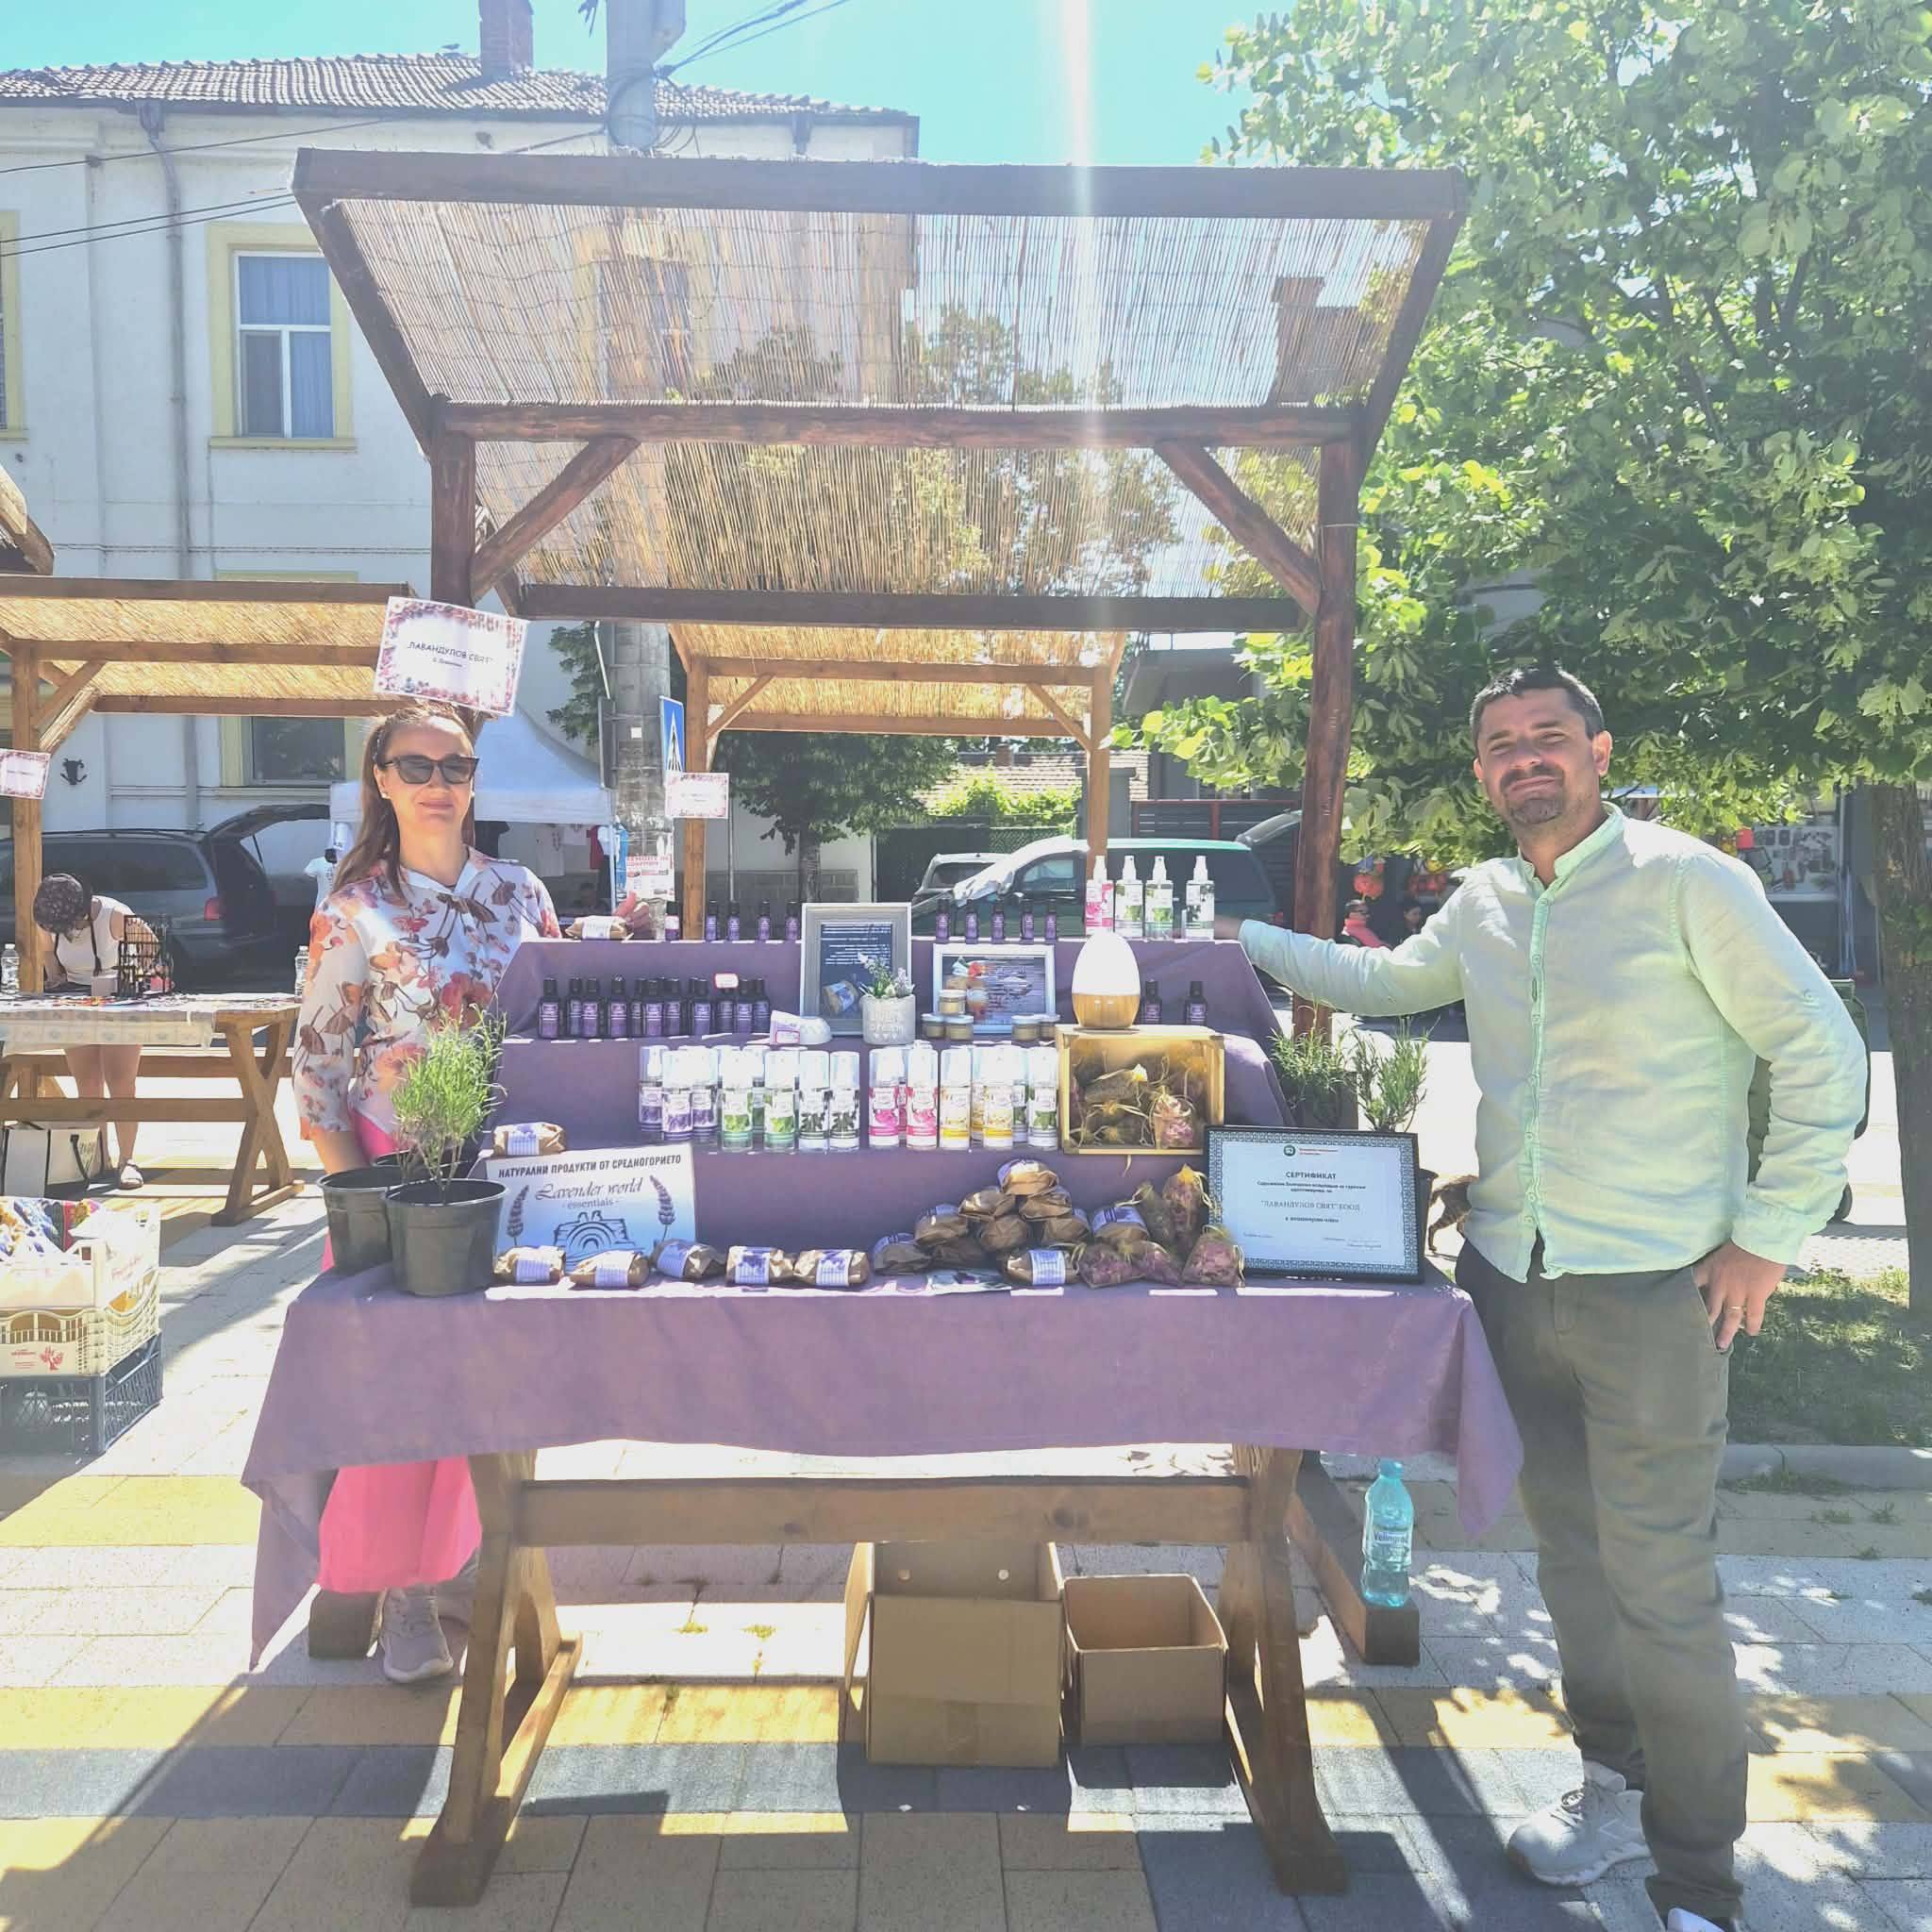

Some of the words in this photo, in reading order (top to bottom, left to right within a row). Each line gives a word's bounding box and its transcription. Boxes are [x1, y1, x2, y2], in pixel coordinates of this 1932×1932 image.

[498, 1164, 549, 1178] НАТУРАЛНИ
[551, 1161, 597, 1174] ПРОДУКТИ
[599, 1160, 611, 1171] ОТ
[612, 1155, 681, 1170] СРЕДНОГОРИЕТО
[1285, 1171, 1337, 1180] СЕРТИФИКАТ
[535, 1180, 604, 1201] Lavender
[608, 1177, 643, 1194] world
